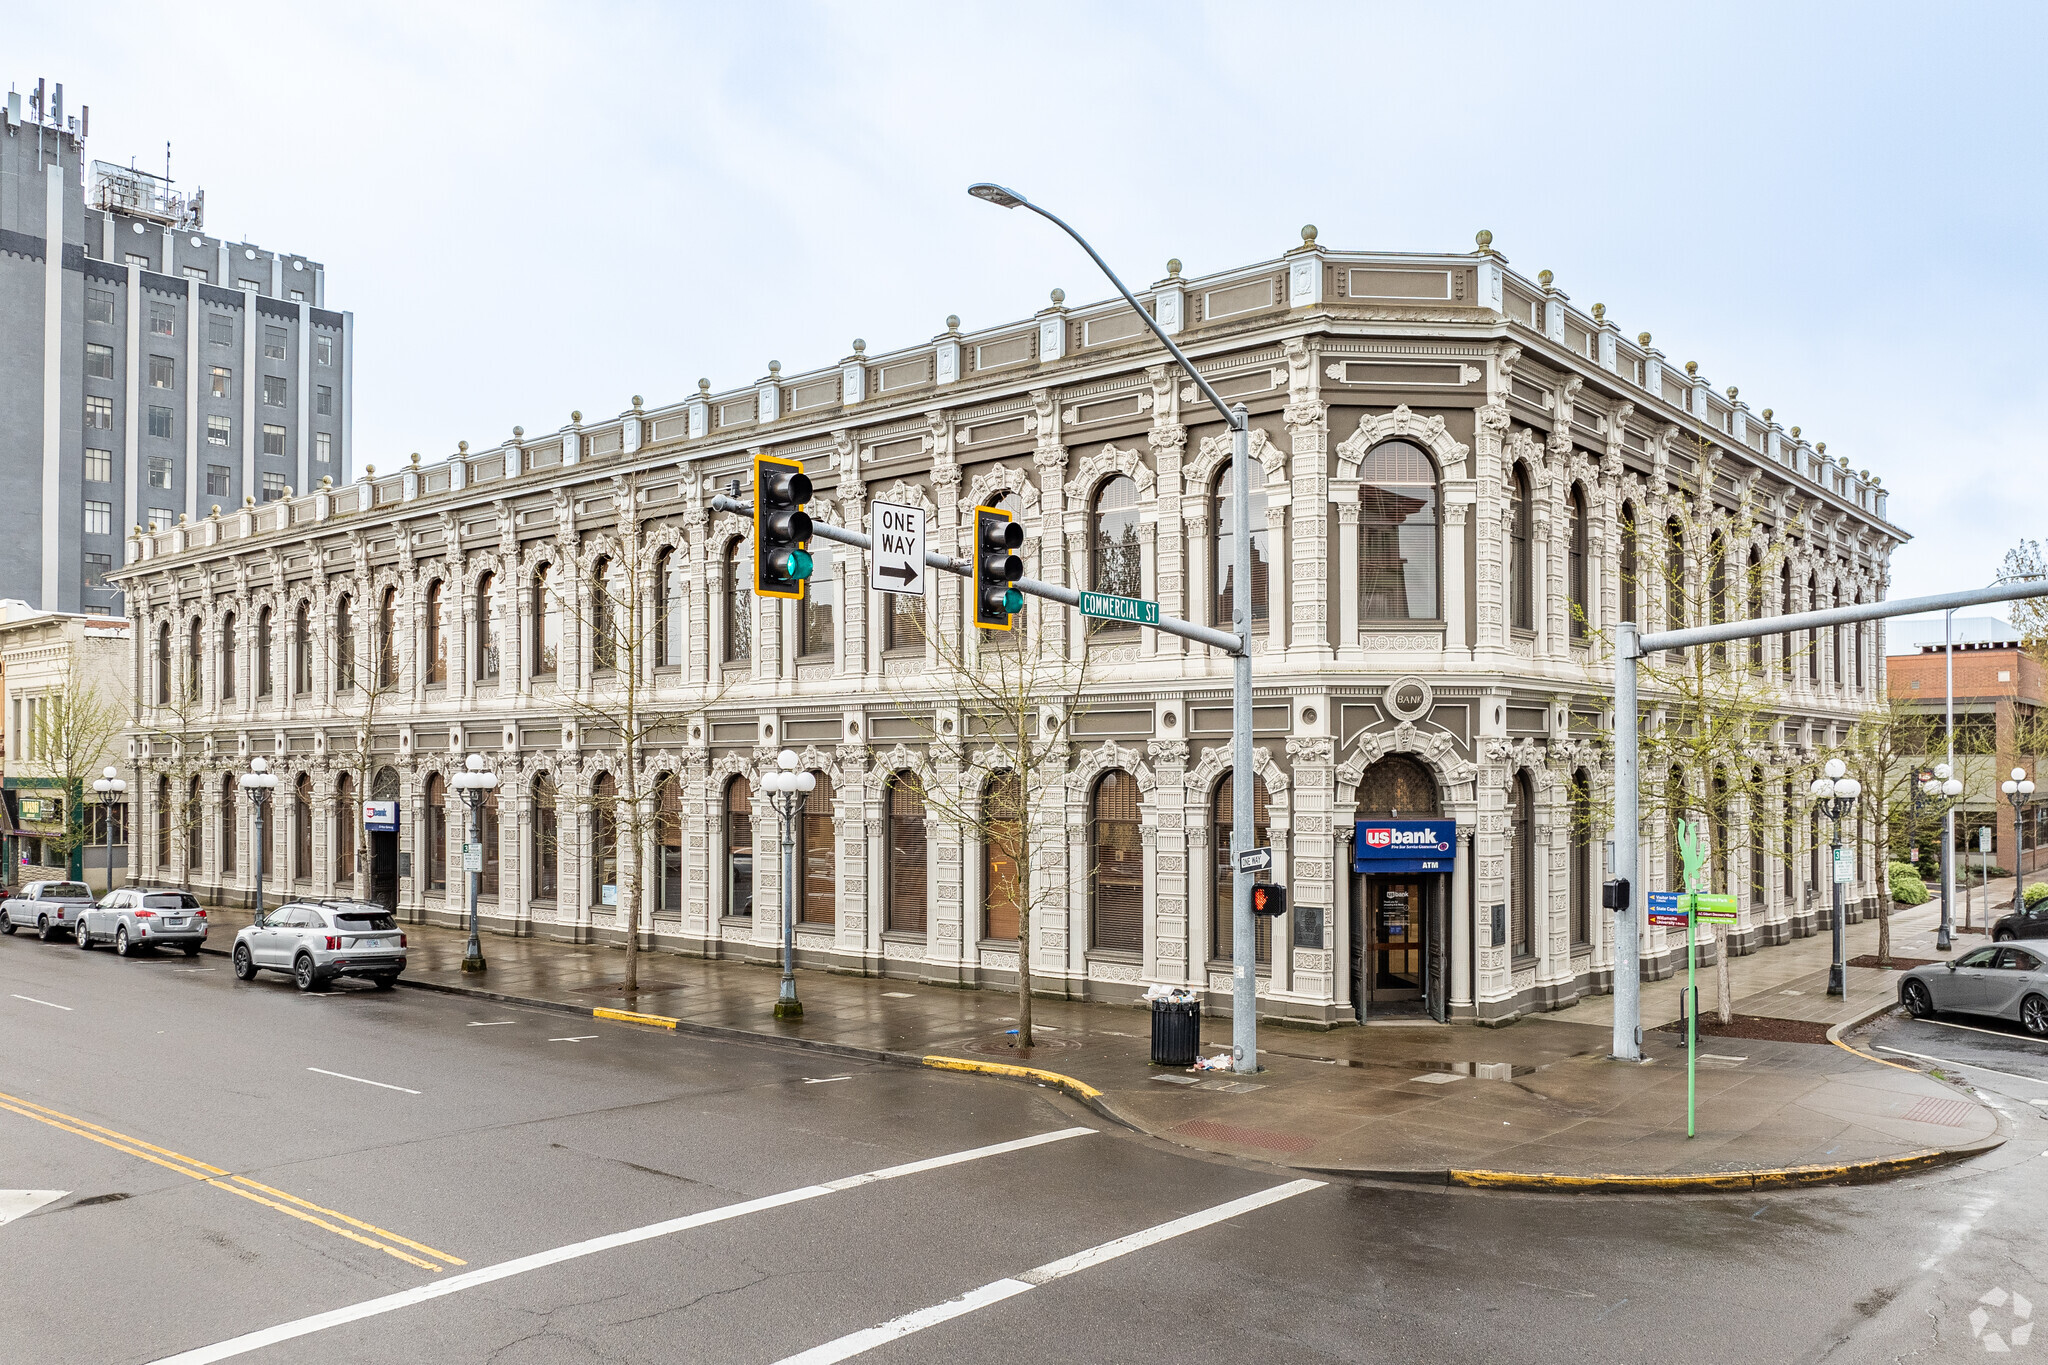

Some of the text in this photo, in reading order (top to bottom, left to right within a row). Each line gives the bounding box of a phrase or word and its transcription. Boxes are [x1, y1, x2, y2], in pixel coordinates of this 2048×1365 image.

[883, 511, 915, 533] ONE
[882, 533, 916, 556] WAY
[1084, 594, 1156, 622] COMMERCIAL ST
[1397, 695, 1422, 704] BANK
[1242, 855, 1261, 867] ONE WAY
[1835, 851, 1840, 860] 3
[1422, 861, 1439, 869] ATM
